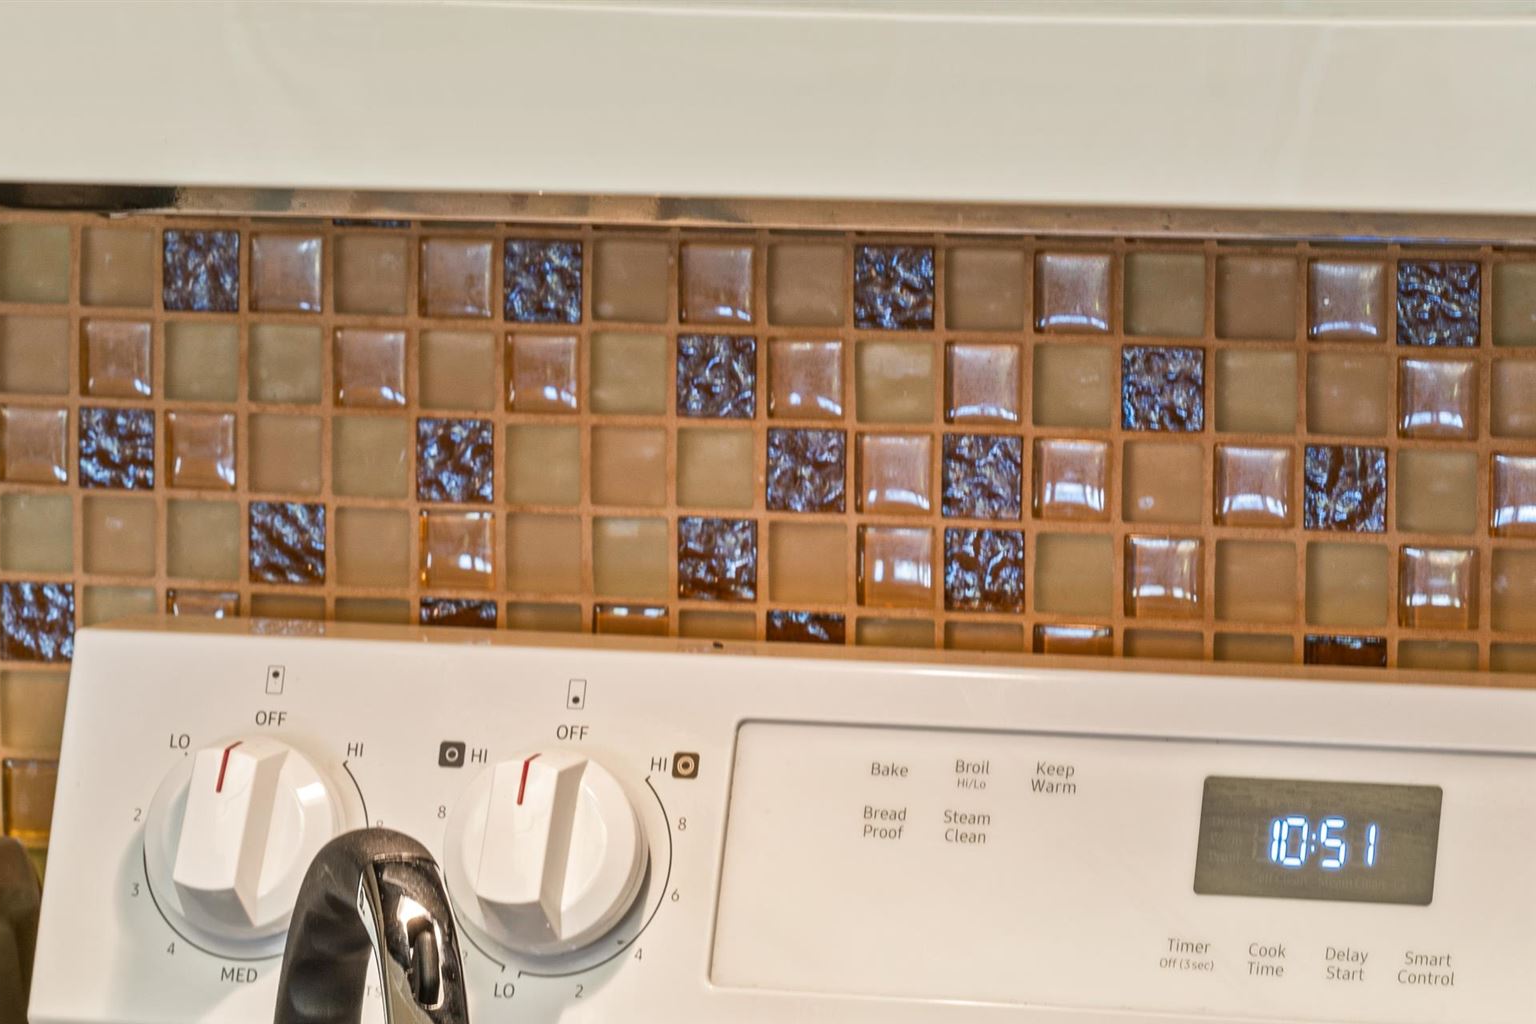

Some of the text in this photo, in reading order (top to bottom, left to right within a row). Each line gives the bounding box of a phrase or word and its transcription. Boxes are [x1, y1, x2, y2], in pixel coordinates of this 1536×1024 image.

[255, 710, 287, 727] OFF
[556, 725, 589, 741] OFF
[169, 734, 190, 749] LO
[346, 743, 364, 757] HI
[470, 749, 488, 763] HI
[650, 757, 667, 772] HI
[870, 761, 909, 778] Bake
[955, 759, 990, 775] Broil
[1036, 760, 1075, 779] Keep
[957, 778, 986, 790] Hi/Lo
[1031, 778, 1077, 795] Warm
[133, 808, 142, 822] 2
[437, 806, 447, 819] 8
[863, 806, 907, 822] Bread
[943, 809, 991, 826] Steam
[678, 817, 687, 831] 8
[863, 824, 904, 840] Proof
[944, 828, 986, 844] Clean
[1271, 817, 1377, 868] 10:51
[131, 883, 140, 896] 3
[671, 890, 679, 902] 6
[167, 943, 175, 956] 4
[634, 947, 643, 960] 4
[1167, 938, 1212, 955] Timer
[1248, 942, 1286, 959] Cook
[1325, 947, 1369, 964] Delay
[1405, 951, 1452, 968] Smart
[1159, 958, 1177, 970] Off
[1247, 962, 1285, 977] Time
[220, 967, 258, 983] MED
[1326, 966, 1365, 982] Start
[1397, 969, 1455, 986] Control
[494, 983, 515, 998] LO
[574, 985, 584, 998] 2
